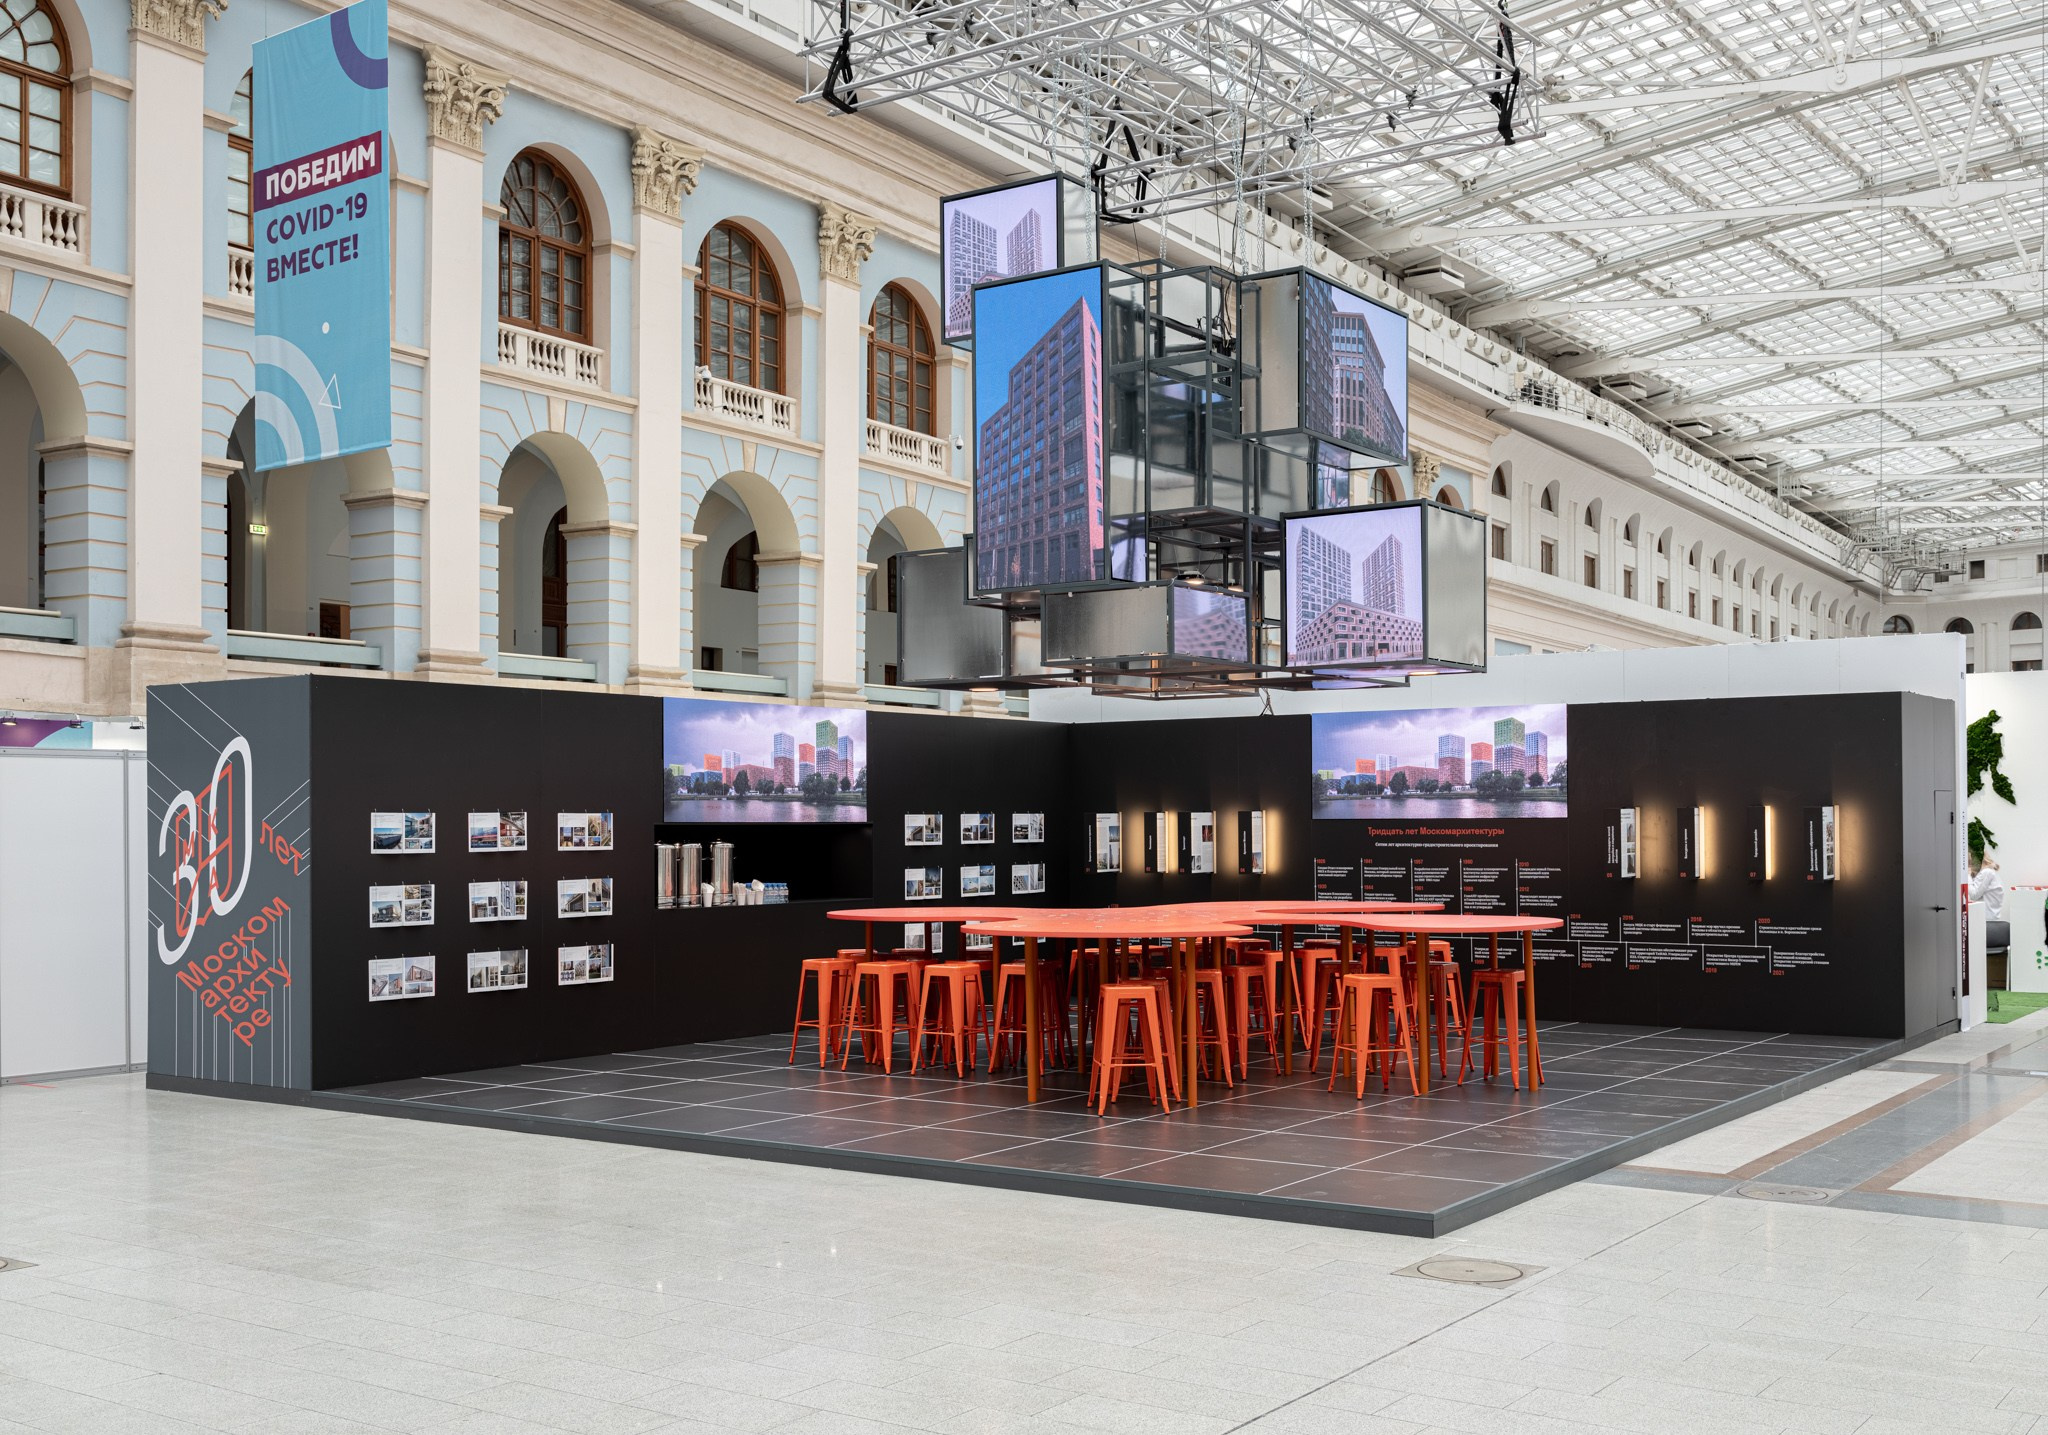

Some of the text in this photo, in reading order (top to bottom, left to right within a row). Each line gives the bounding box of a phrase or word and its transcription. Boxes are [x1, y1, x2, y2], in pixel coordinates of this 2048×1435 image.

[266, 141, 375, 200] ПОБЕДИМ
[266, 192, 368, 245] COVID-19
[267, 233, 359, 283] ВМЕСТЕ!
[259, 820, 303, 876] лет
[1367, 826, 1404, 837] Тридцать
[1419, 826, 1505, 837] Москомархитектуры
[176, 896, 291, 992] Моском
[200, 948, 268, 1008] архи
[214, 958, 292, 1023] текту
[232, 1009, 271, 1047] ре
